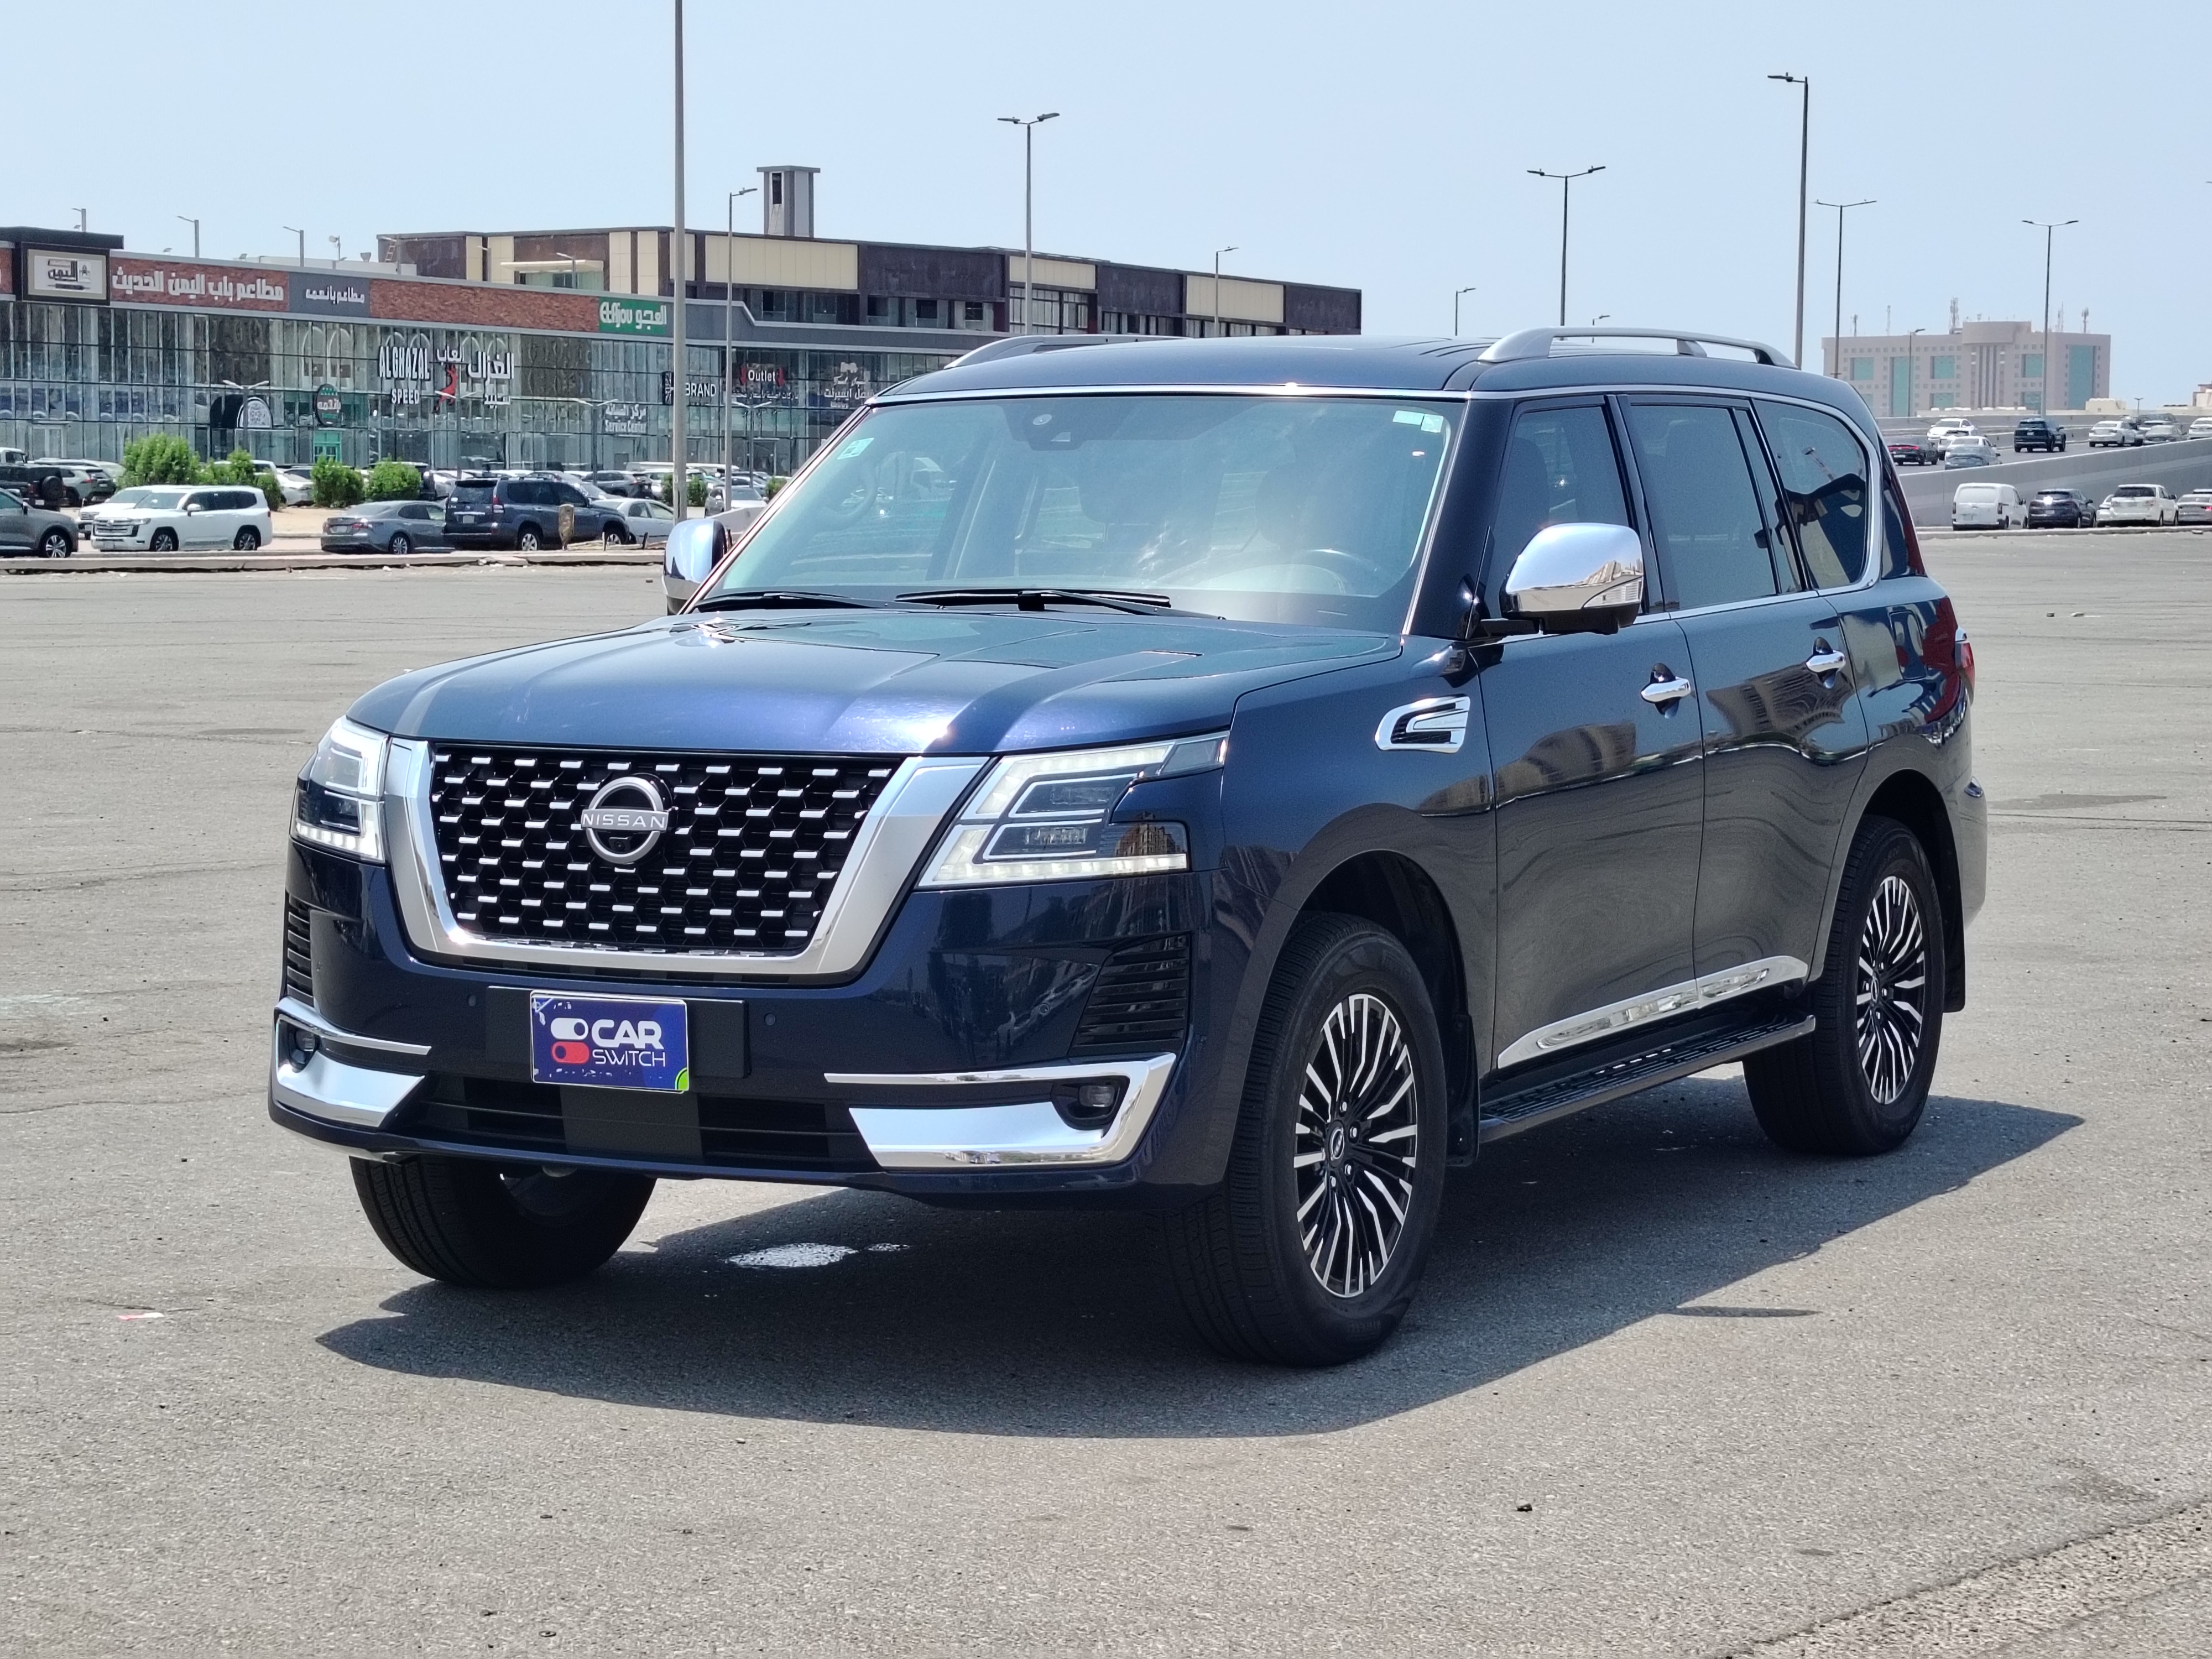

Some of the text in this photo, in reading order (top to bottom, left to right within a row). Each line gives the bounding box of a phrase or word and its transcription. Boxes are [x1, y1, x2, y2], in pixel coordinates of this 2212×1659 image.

[111, 265, 284, 302] مطاعم باب اليمن الحديث
[337, 286, 365, 304] مطاعم
[468, 351, 515, 386] الغزال
[748, 369, 775, 382] Outlet
[391, 388, 420, 404] SPEED
[686, 382, 717, 398] BRAND
[582, 813, 665, 828] NISSAN
[591, 1019, 664, 1050] CAR
[592, 1048, 666, 1067] SWITCH
